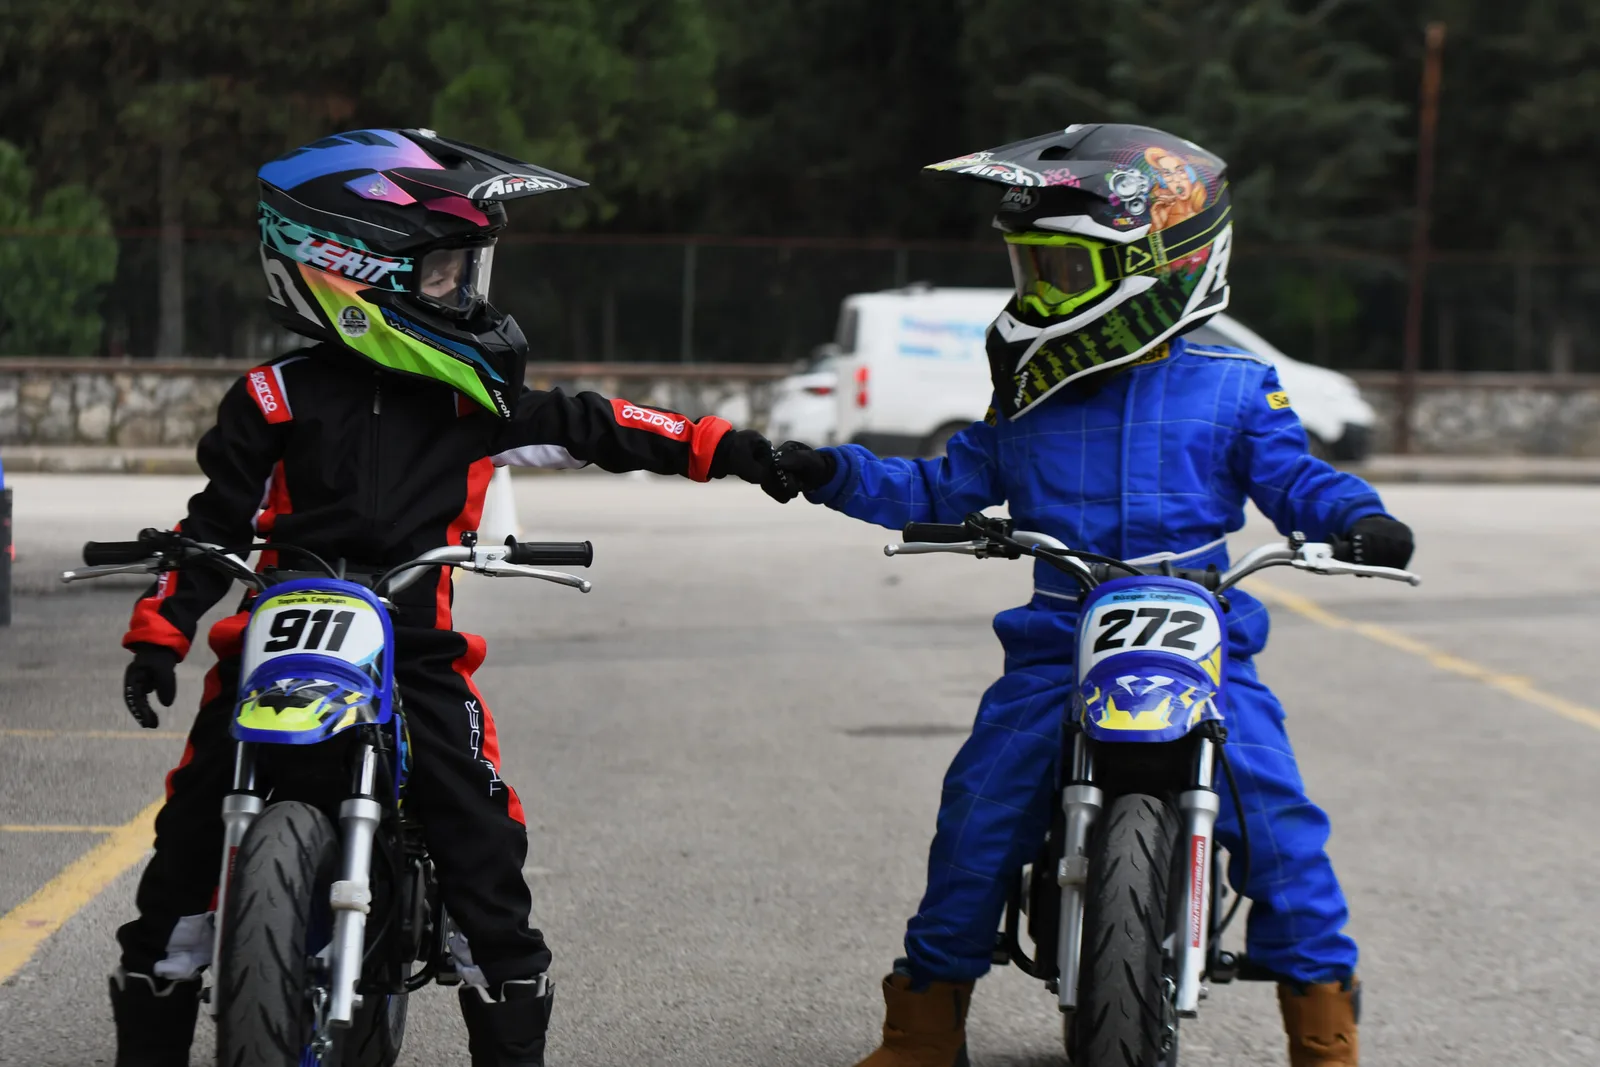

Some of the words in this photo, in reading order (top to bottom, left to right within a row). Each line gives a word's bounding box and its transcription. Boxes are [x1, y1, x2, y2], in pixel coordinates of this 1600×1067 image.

[483, 178, 561, 199] Airoh
[958, 164, 1034, 187] Airoh
[493, 388, 511, 419] Airoh
[1014, 371, 1030, 408] Airoh
[263, 608, 356, 653] 911
[1093, 607, 1206, 654] 272
